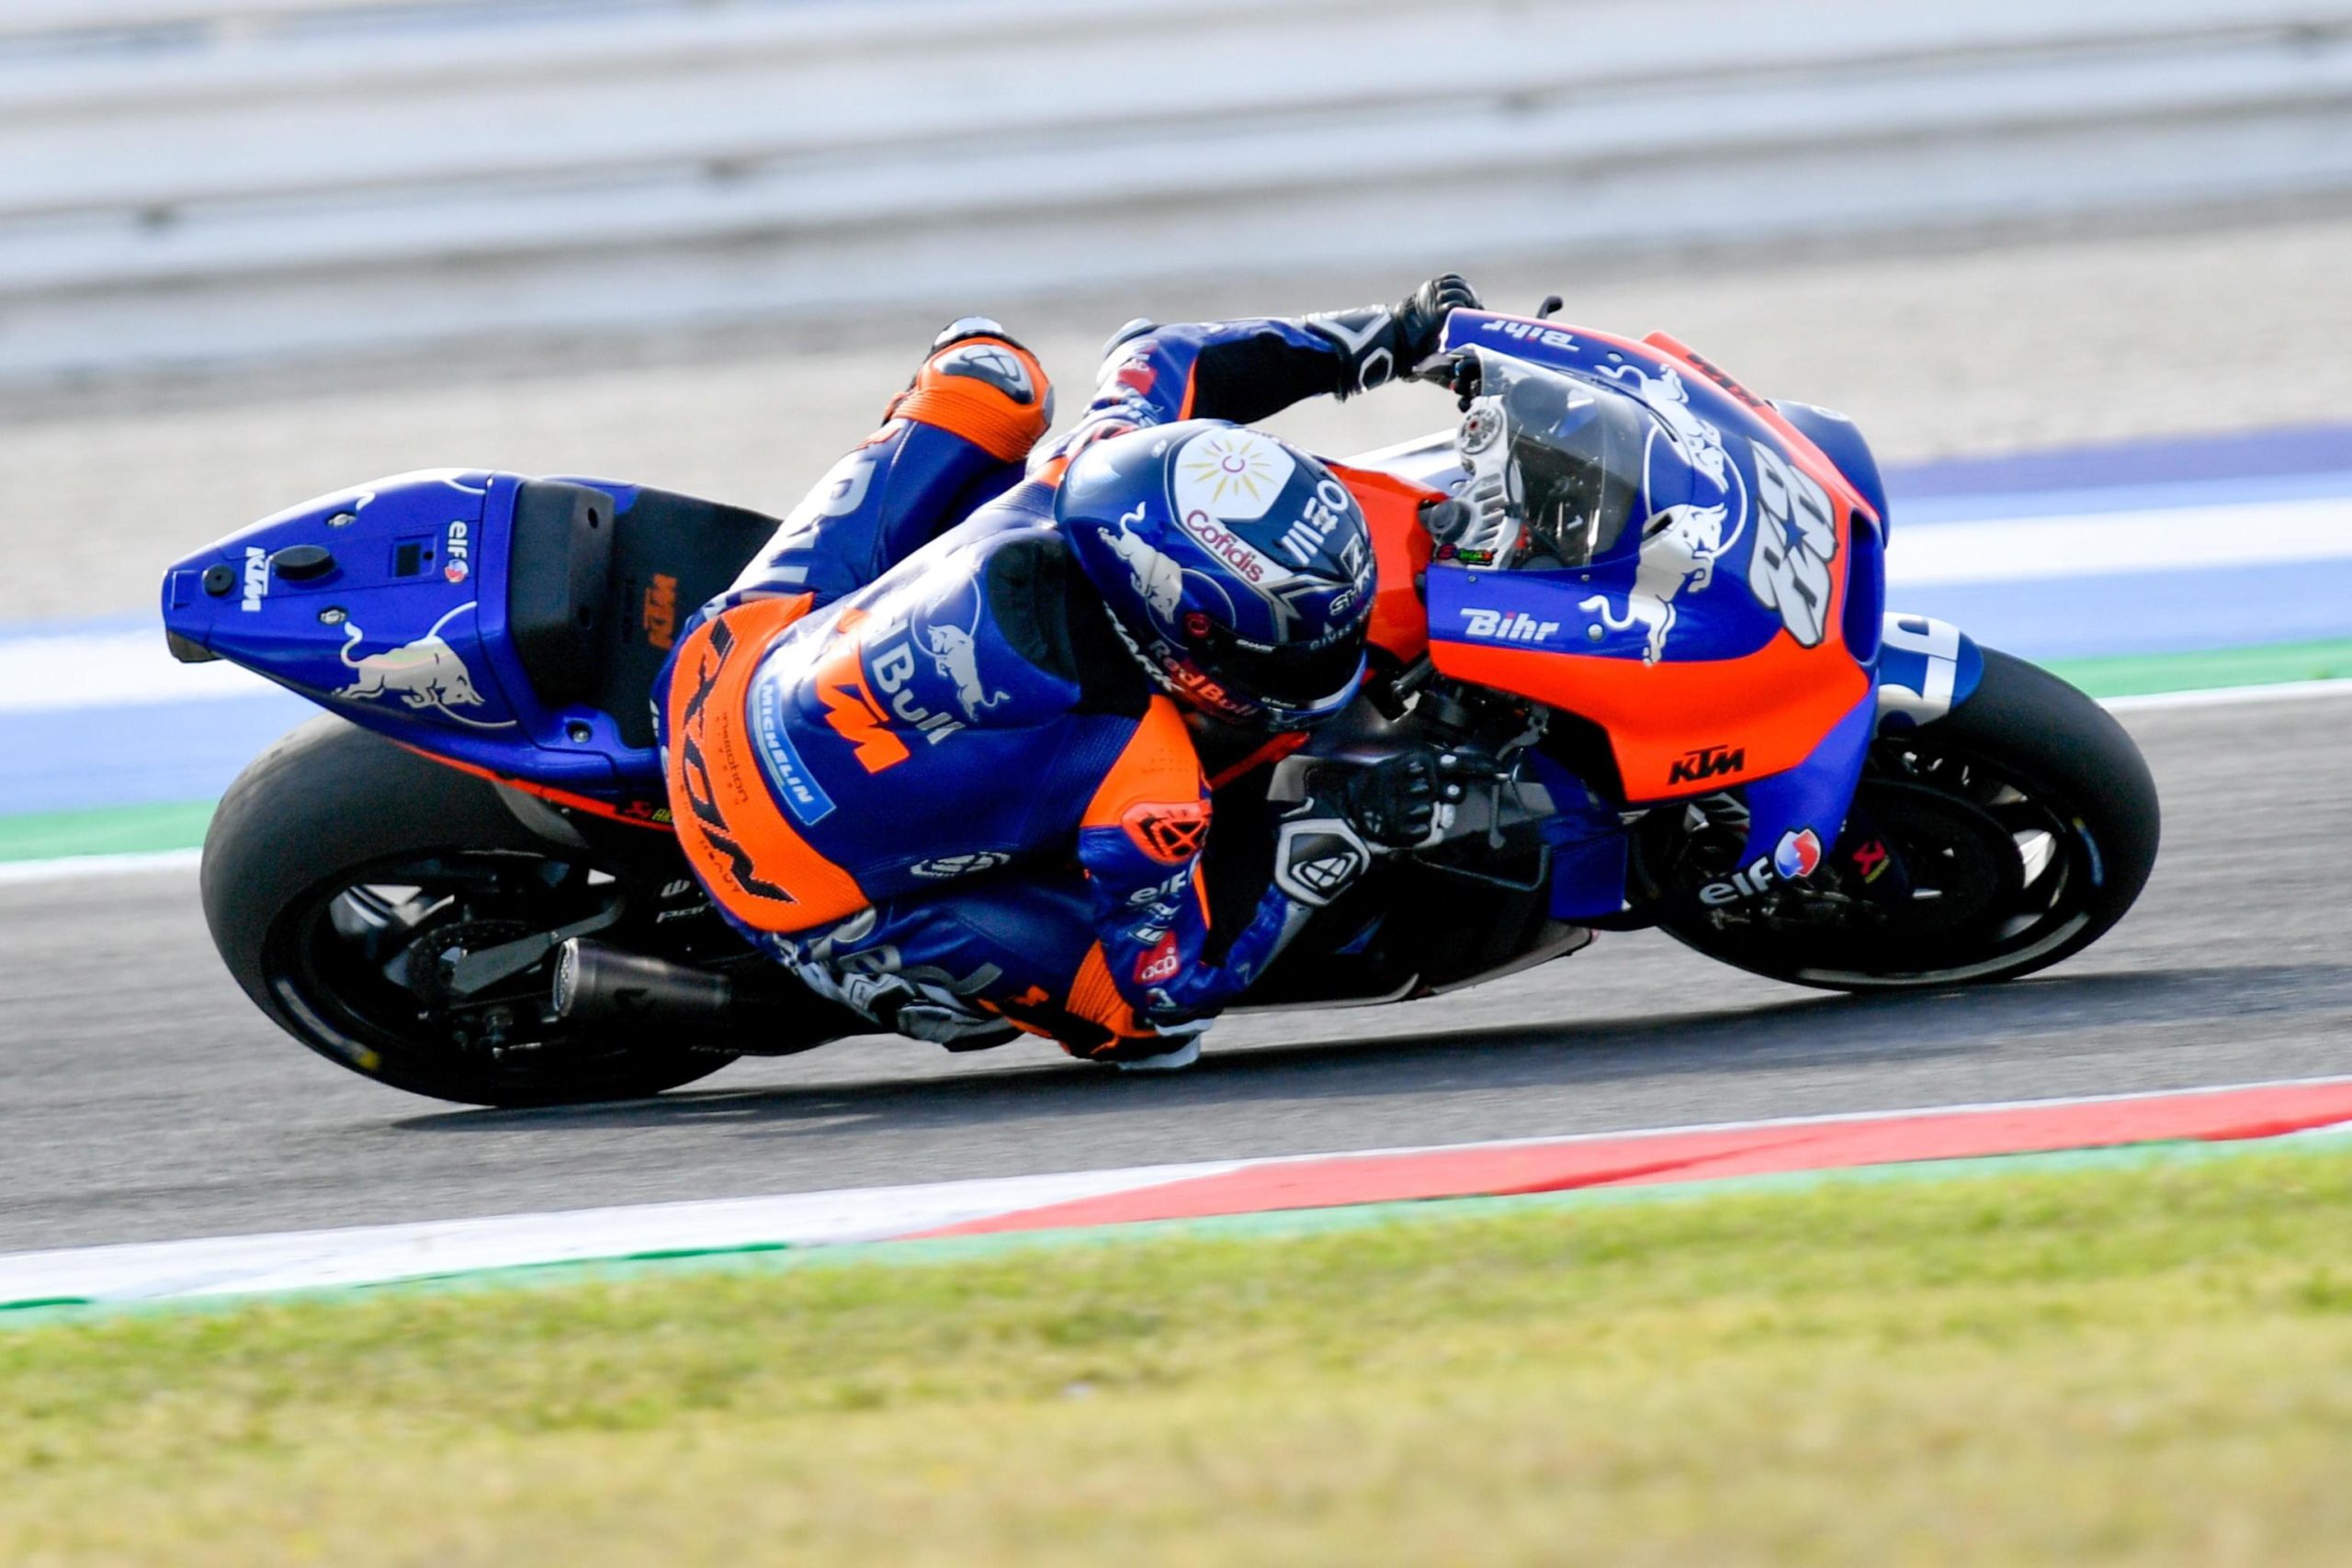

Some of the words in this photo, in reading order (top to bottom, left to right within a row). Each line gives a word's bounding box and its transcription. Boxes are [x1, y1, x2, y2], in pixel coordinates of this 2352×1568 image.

[1481, 320, 1580, 353] Bihr
[447, 520, 469, 558] elf
[1186, 510, 1265, 582] Cofidis
[1748, 440, 1838, 650] 88
[242, 546, 268, 612] KTM
[1460, 606, 1560, 643] Bihr
[871, 641, 966, 745] Bull
[759, 683, 815, 805] MICHELIN
[1668, 745, 1745, 785] KTM
[1126, 870, 1187, 906] elf
[1698, 860, 1775, 908] elf
